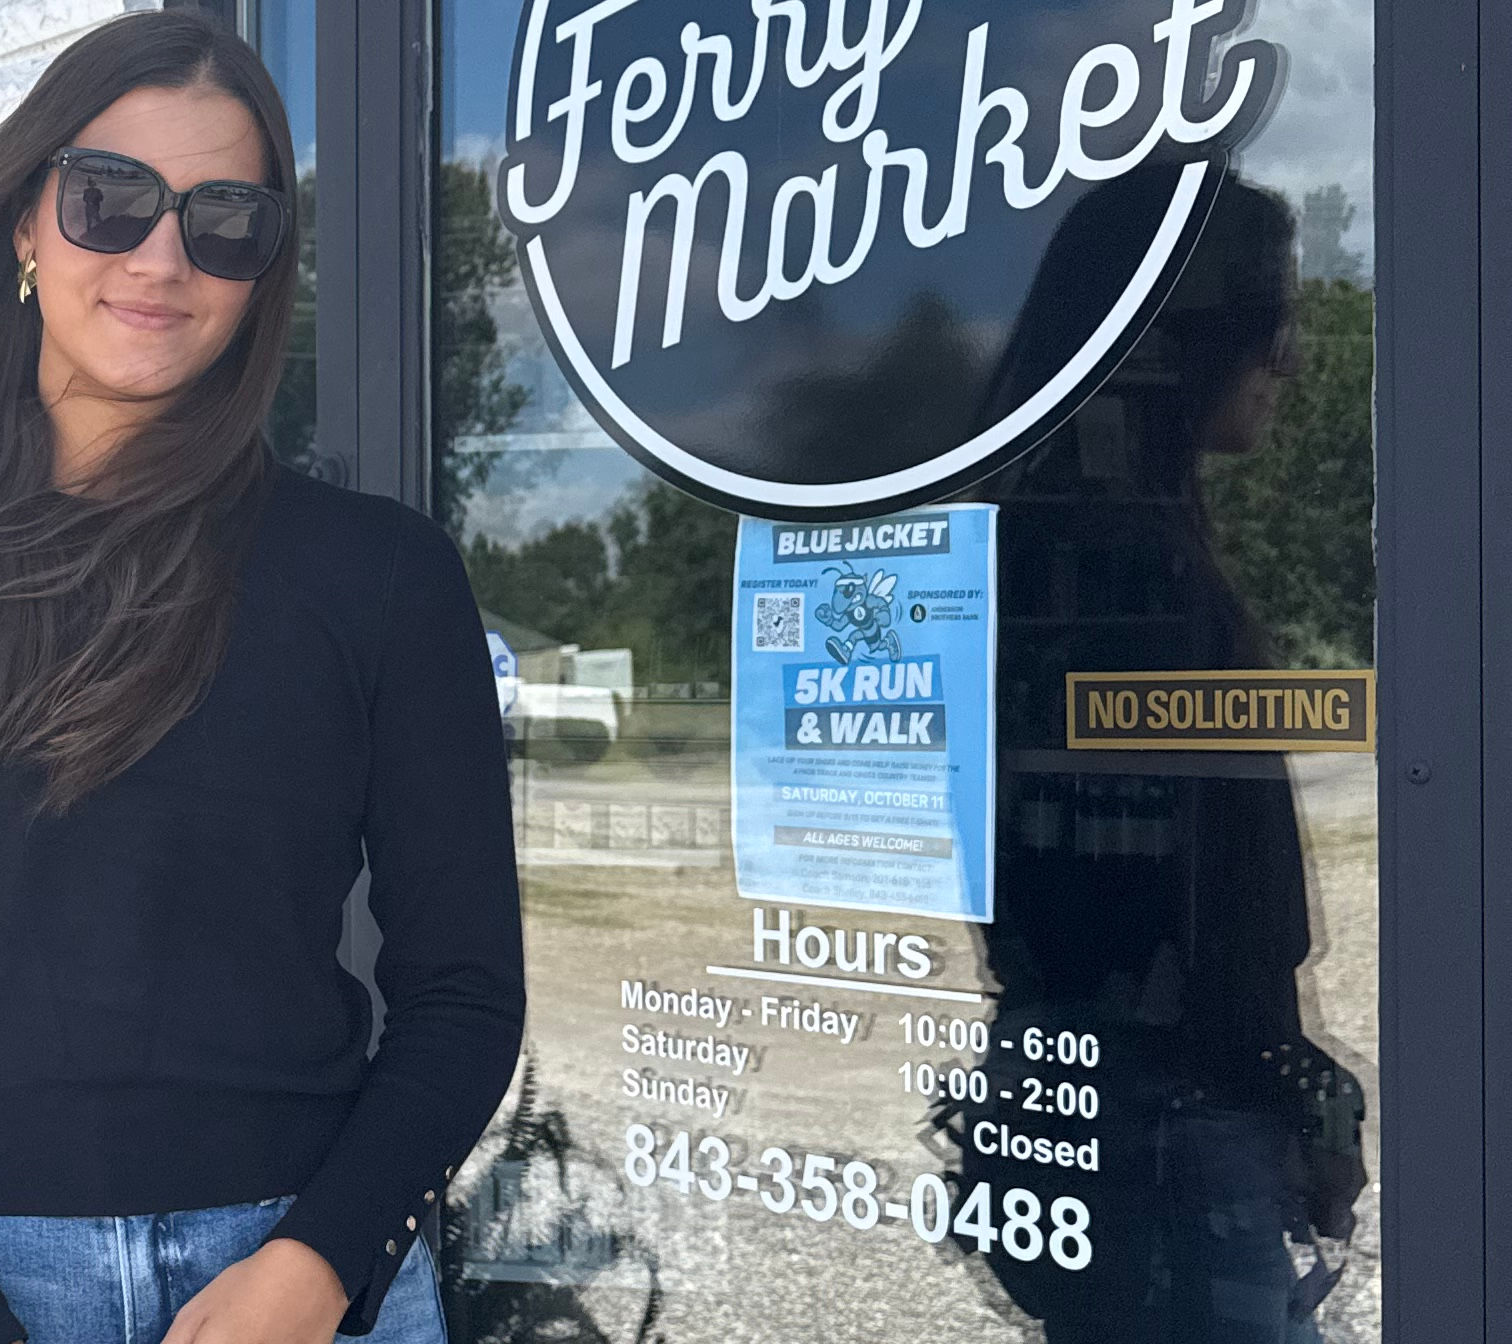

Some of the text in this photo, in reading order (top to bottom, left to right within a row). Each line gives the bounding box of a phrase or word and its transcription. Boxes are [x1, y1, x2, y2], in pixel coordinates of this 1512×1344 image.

[777, 521, 948, 556] BLUE JACKET
[741, 578, 818, 589] REGISTER TODAY!
[907, 589, 984, 600] SPONSORED BY:
[794, 661, 933, 704] 5K RUN
[796, 712, 934, 745] & WALK
[1088, 688, 1350, 730] NO SOLICITING
[781, 786, 944, 809] SATURDAY, OCTOBER 11
[803, 832, 924, 852] ALL AGES WELCOME!
[753, 907, 931, 979] Hours
[620, 980, 732, 1027] Monday
[761, 996, 859, 1044] Friday
[898, 1012, 988, 1054] 10:00
[1022, 1027, 1100, 1068] 6:00
[621, 1024, 749, 1075] Saturday
[898, 1061, 988, 1104] 10:00
[1022, 1078, 1100, 1120] 2:00
[621, 1069, 1100, 1172] Sunday Closed
[624, 1123, 1093, 1271] 843-358-0488
